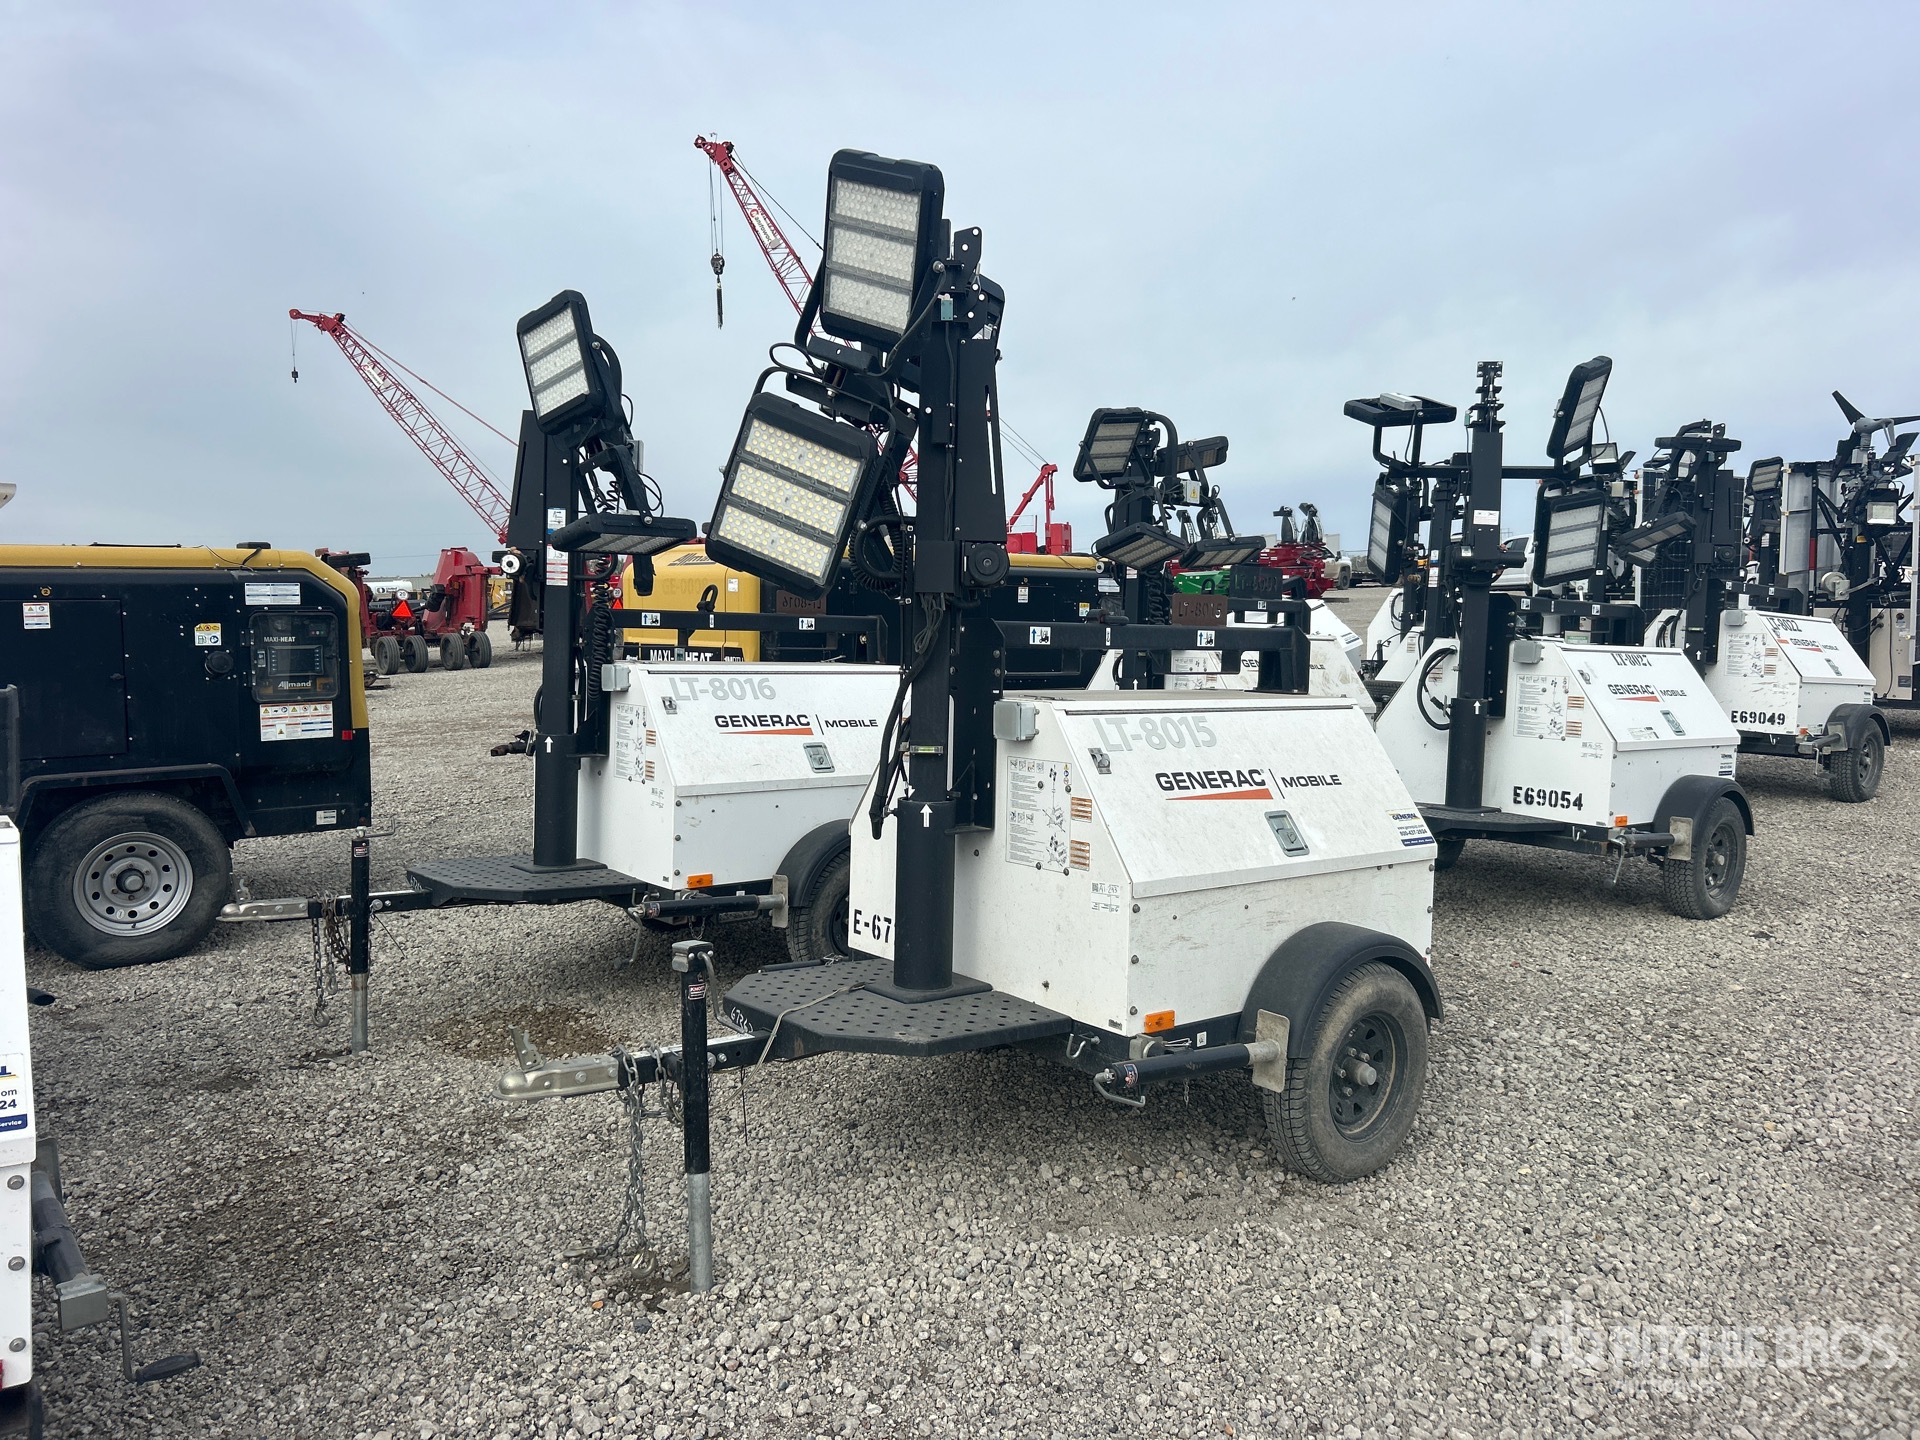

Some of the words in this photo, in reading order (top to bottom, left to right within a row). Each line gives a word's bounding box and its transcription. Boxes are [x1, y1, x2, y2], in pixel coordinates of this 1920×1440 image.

[278, 680, 312, 690] Allmand
[668, 677, 777, 701] LT-8016
[1608, 684, 1655, 695] GENERAC
[1659, 689, 1688, 697] MOBILE
[714, 714, 811, 728] GENERAC
[824, 719, 878, 728] MOBILE
[1731, 710, 1786, 725] E69049
[1092, 715, 1217, 752] LT-8015
[1155, 768, 1267, 791] GENERAC
[1280, 774, 1342, 788] MOBILE
[1513, 785, 1584, 811] E69054
